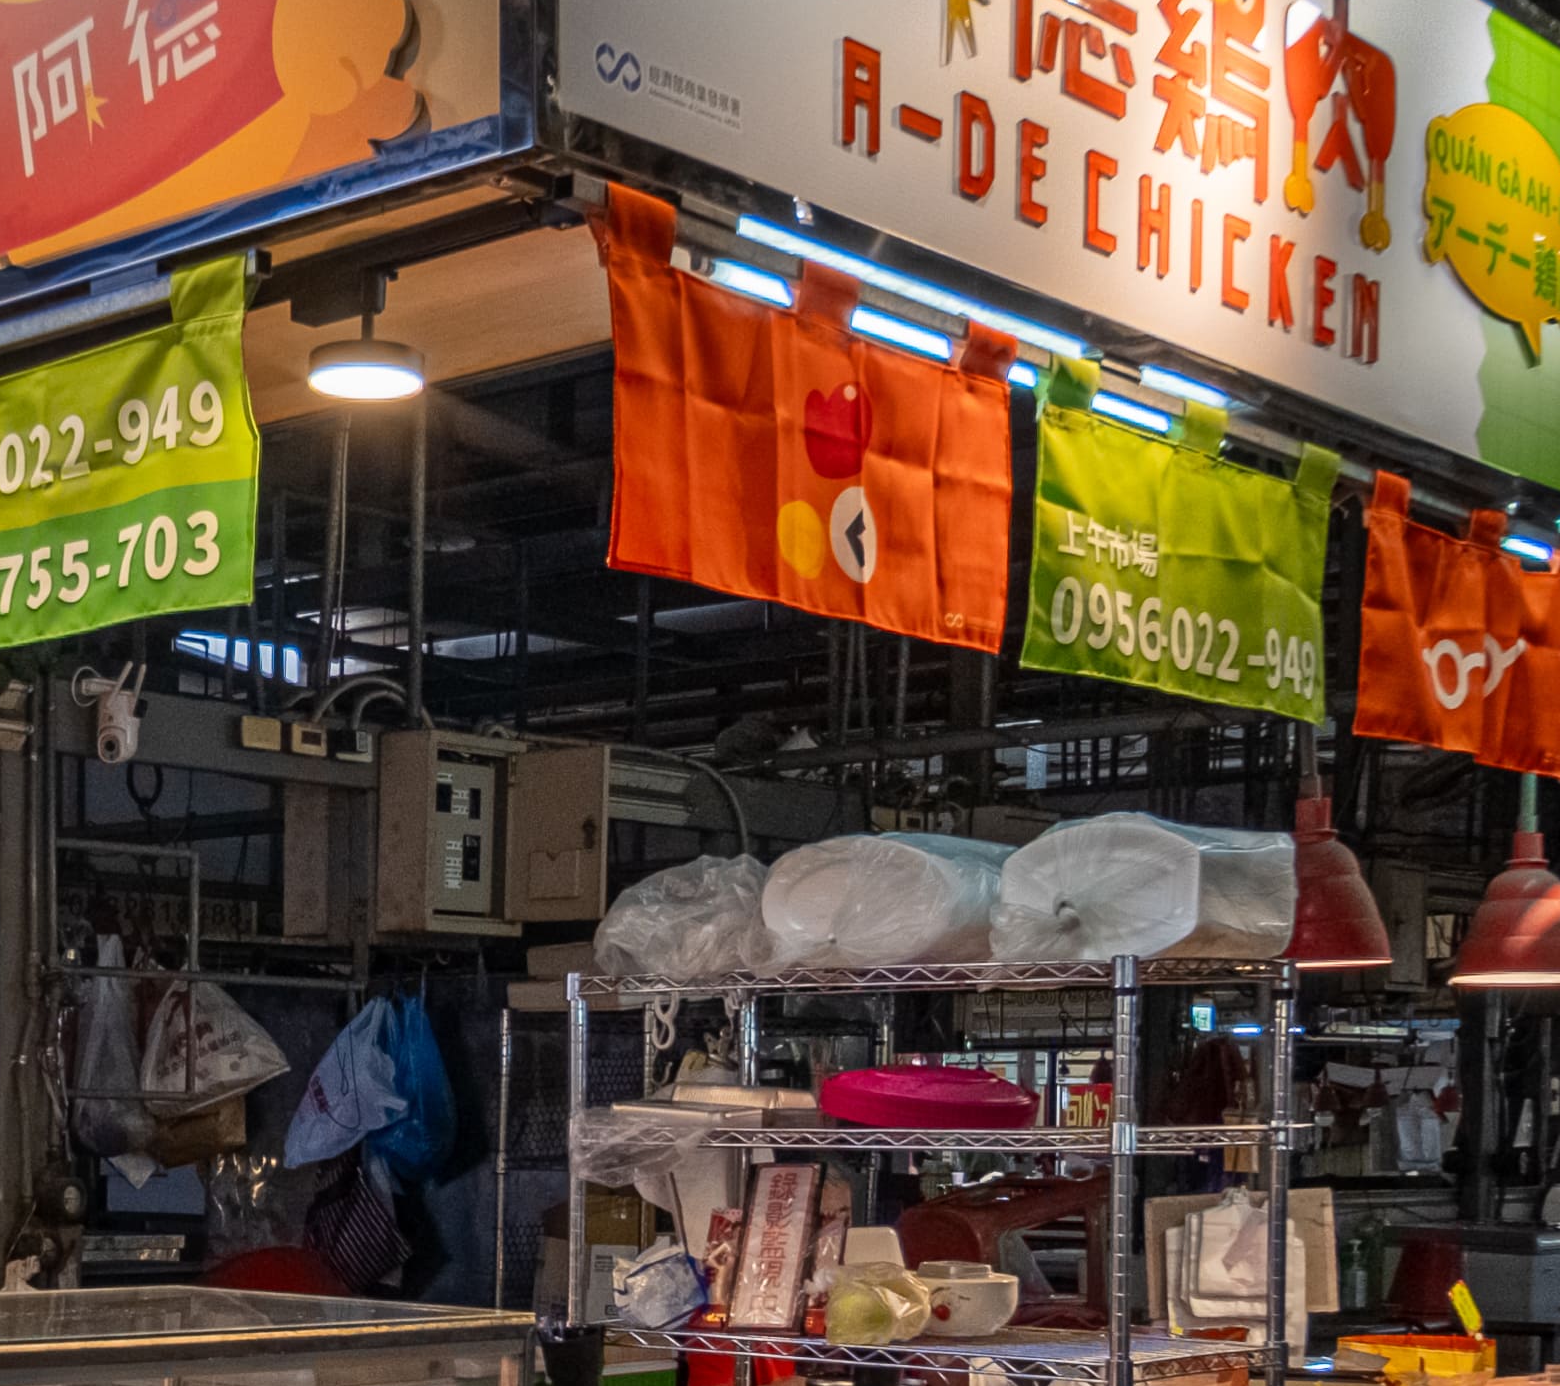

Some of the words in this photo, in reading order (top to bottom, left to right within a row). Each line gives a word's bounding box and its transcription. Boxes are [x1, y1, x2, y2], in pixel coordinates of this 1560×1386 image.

[839, 36, 1049, 226] A-DE
[1083, 147, 1381, 366] CHICKEN
[1434, 127, 1493, 187] QUÁN
[1497, 153, 1522, 203] GÀ
[1057, 511, 1159, 580] 上午市場
[1050, 576, 1316, 701] 0956-022-949
